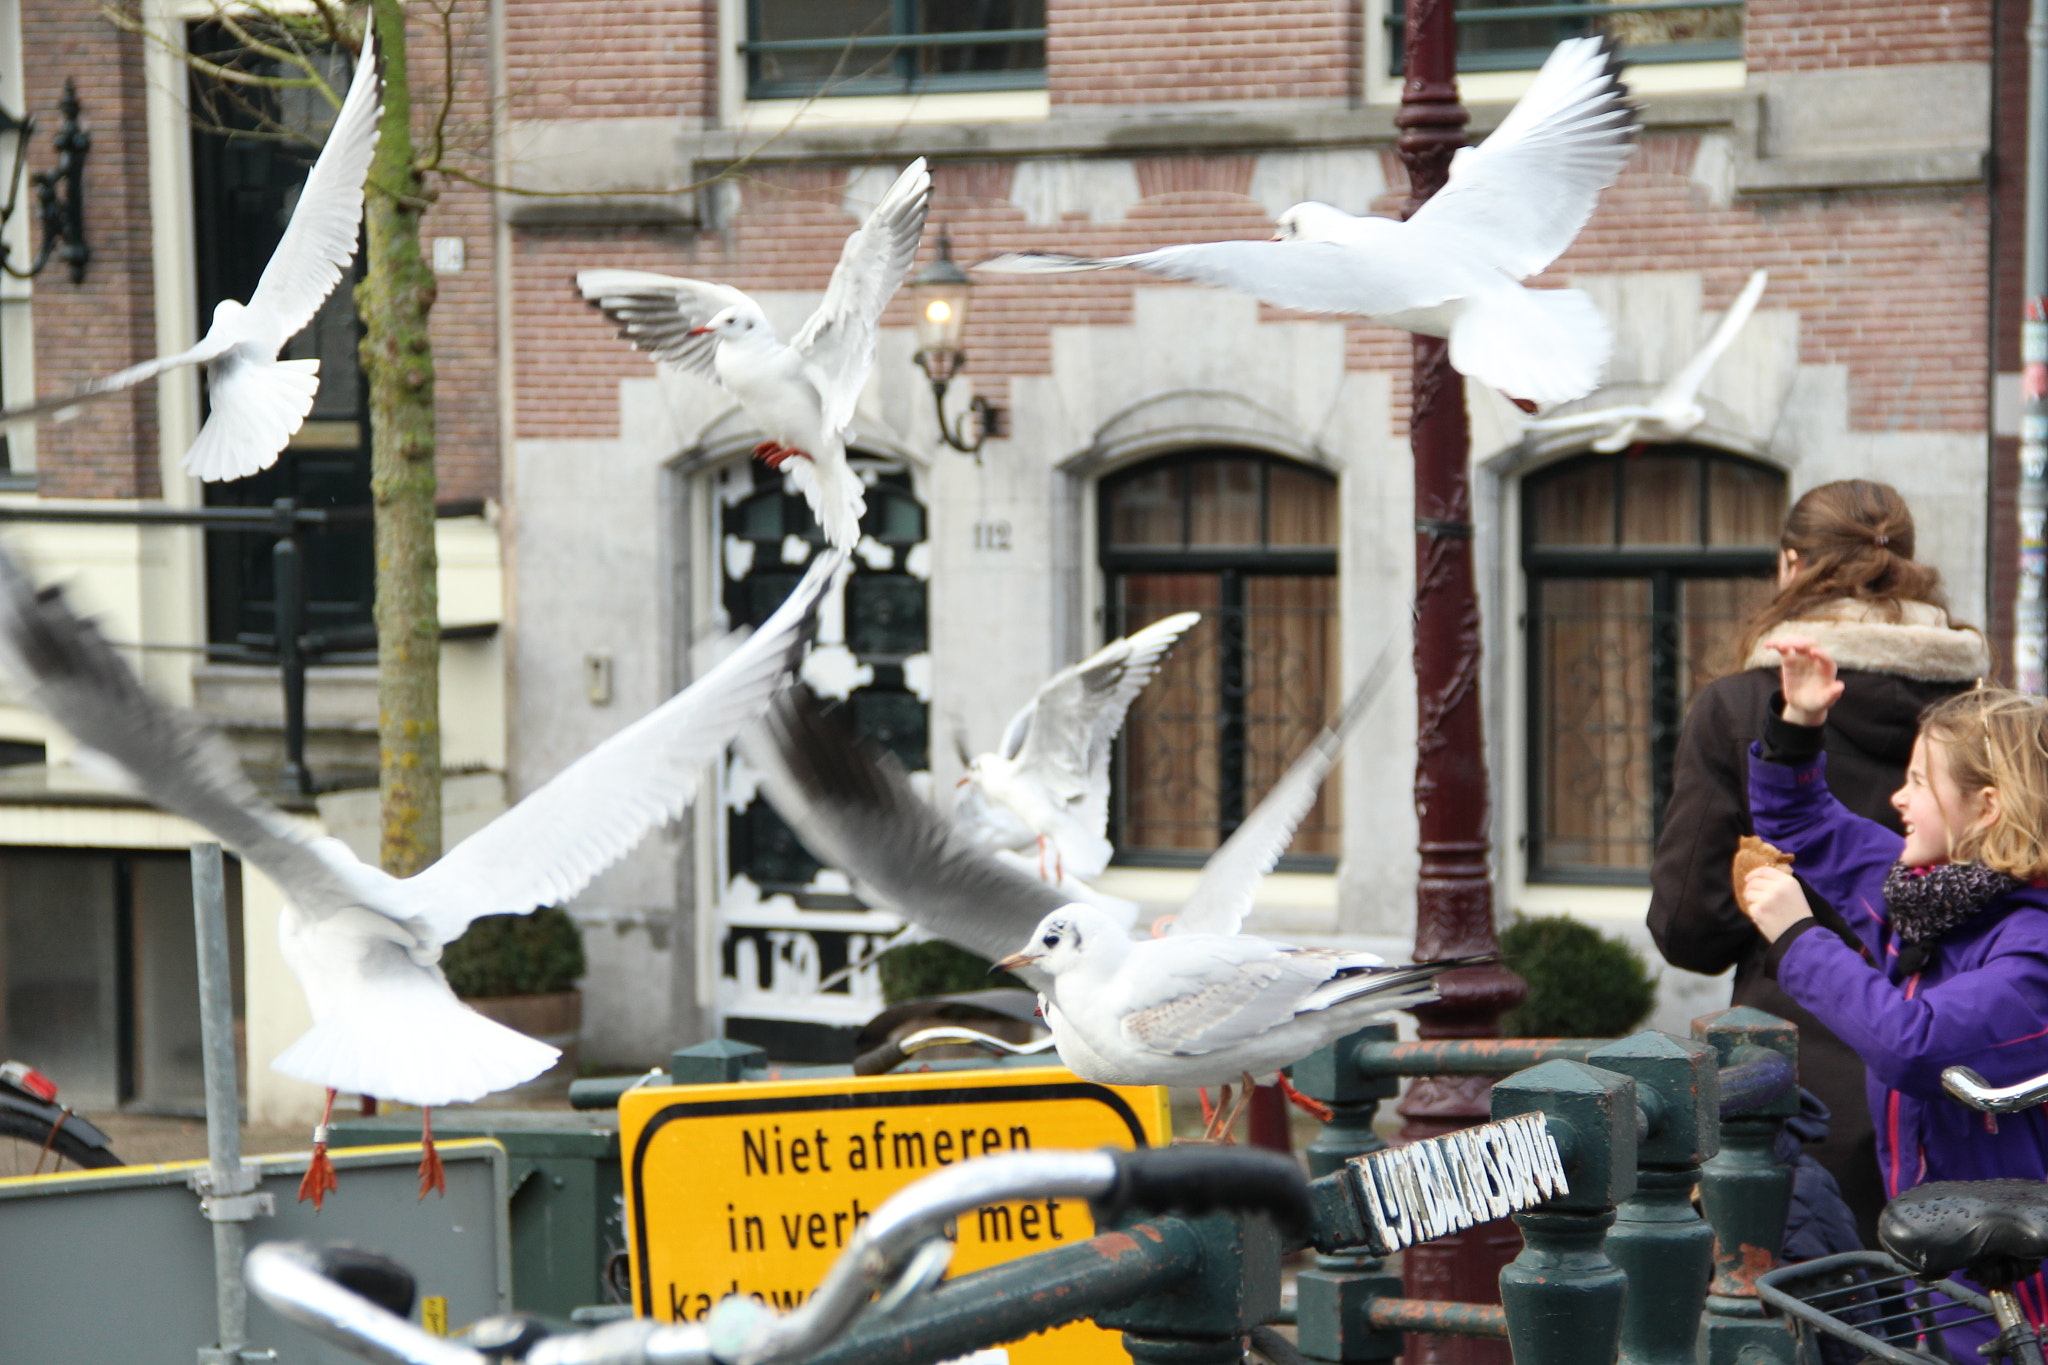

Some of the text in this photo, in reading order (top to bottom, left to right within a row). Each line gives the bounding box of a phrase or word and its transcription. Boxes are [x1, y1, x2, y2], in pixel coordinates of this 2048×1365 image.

[974, 520, 1012, 551] 112
[743, 1120, 1030, 1176] Niet afmeren
[728, 1203, 765, 1252] in
[979, 1197, 1063, 1242] met
